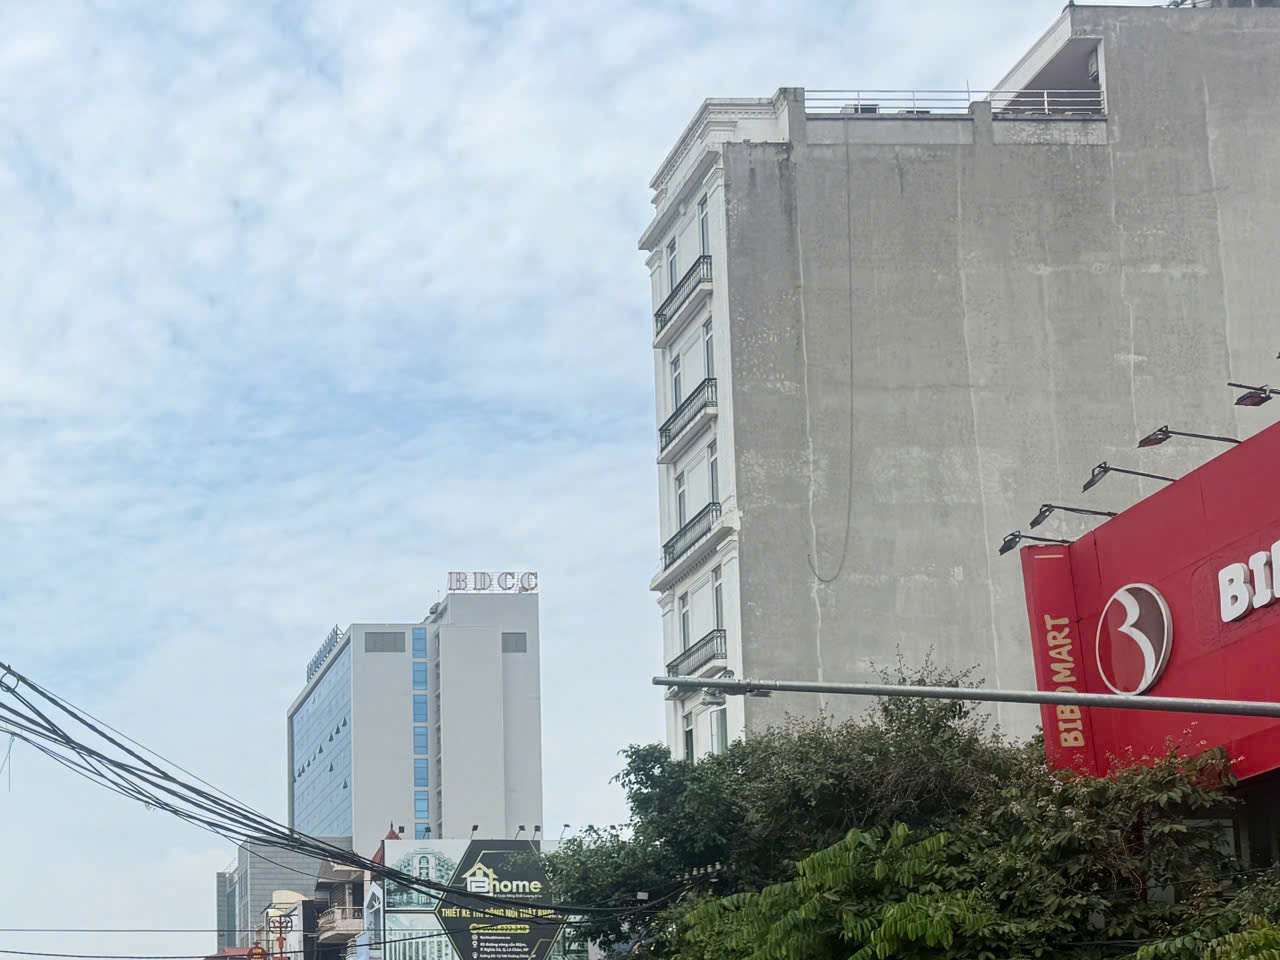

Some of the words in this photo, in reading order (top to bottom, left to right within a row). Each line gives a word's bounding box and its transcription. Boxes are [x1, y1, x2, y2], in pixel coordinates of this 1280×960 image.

[448, 571, 538, 591] BDCC
[1218, 540, 1280, 623] BI
[1044, 614, 1077, 683] MART
[442, 906, 460, 918] THIẾT
